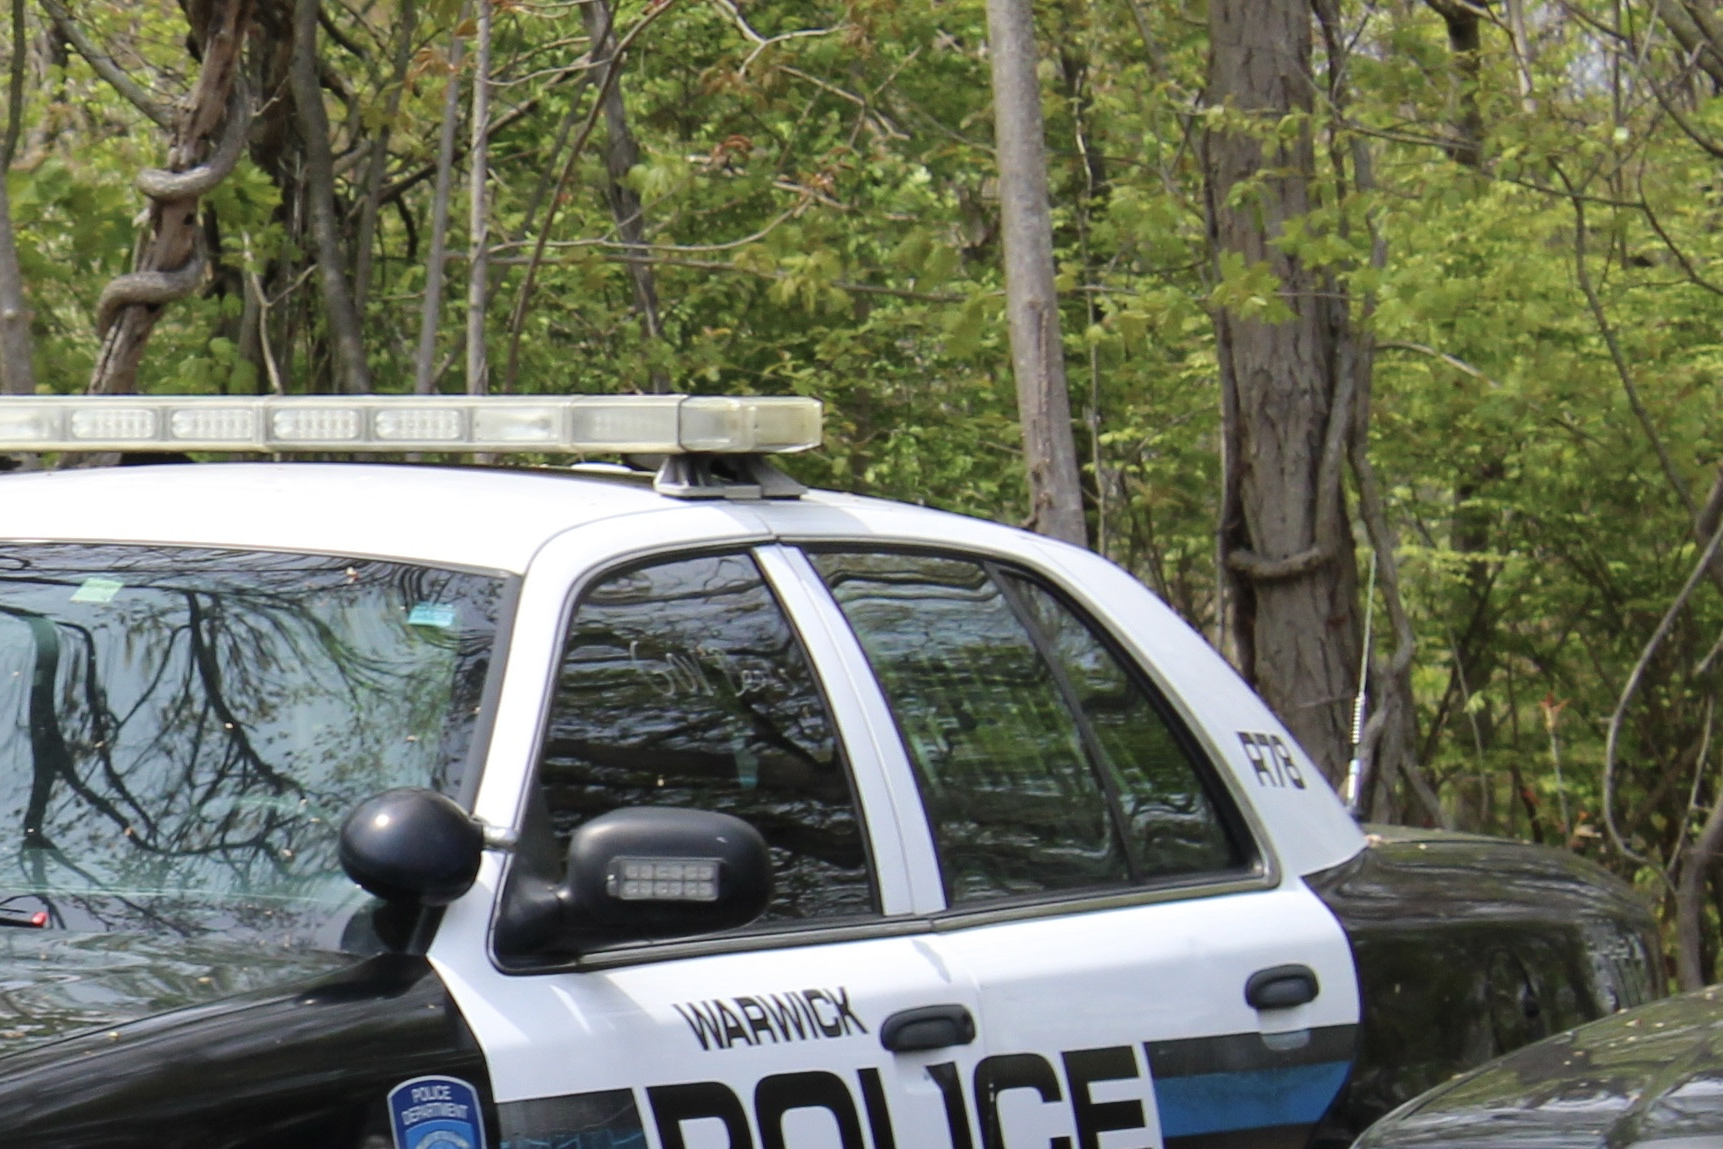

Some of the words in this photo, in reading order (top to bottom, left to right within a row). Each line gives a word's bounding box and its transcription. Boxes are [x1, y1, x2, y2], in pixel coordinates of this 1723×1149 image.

[1236, 731, 1306, 789] R78
[672, 987, 869, 1050] WARWICK
[401, 1102, 468, 1126] DEPARTMENT
[411, 1085, 452, 1104] POLICE
